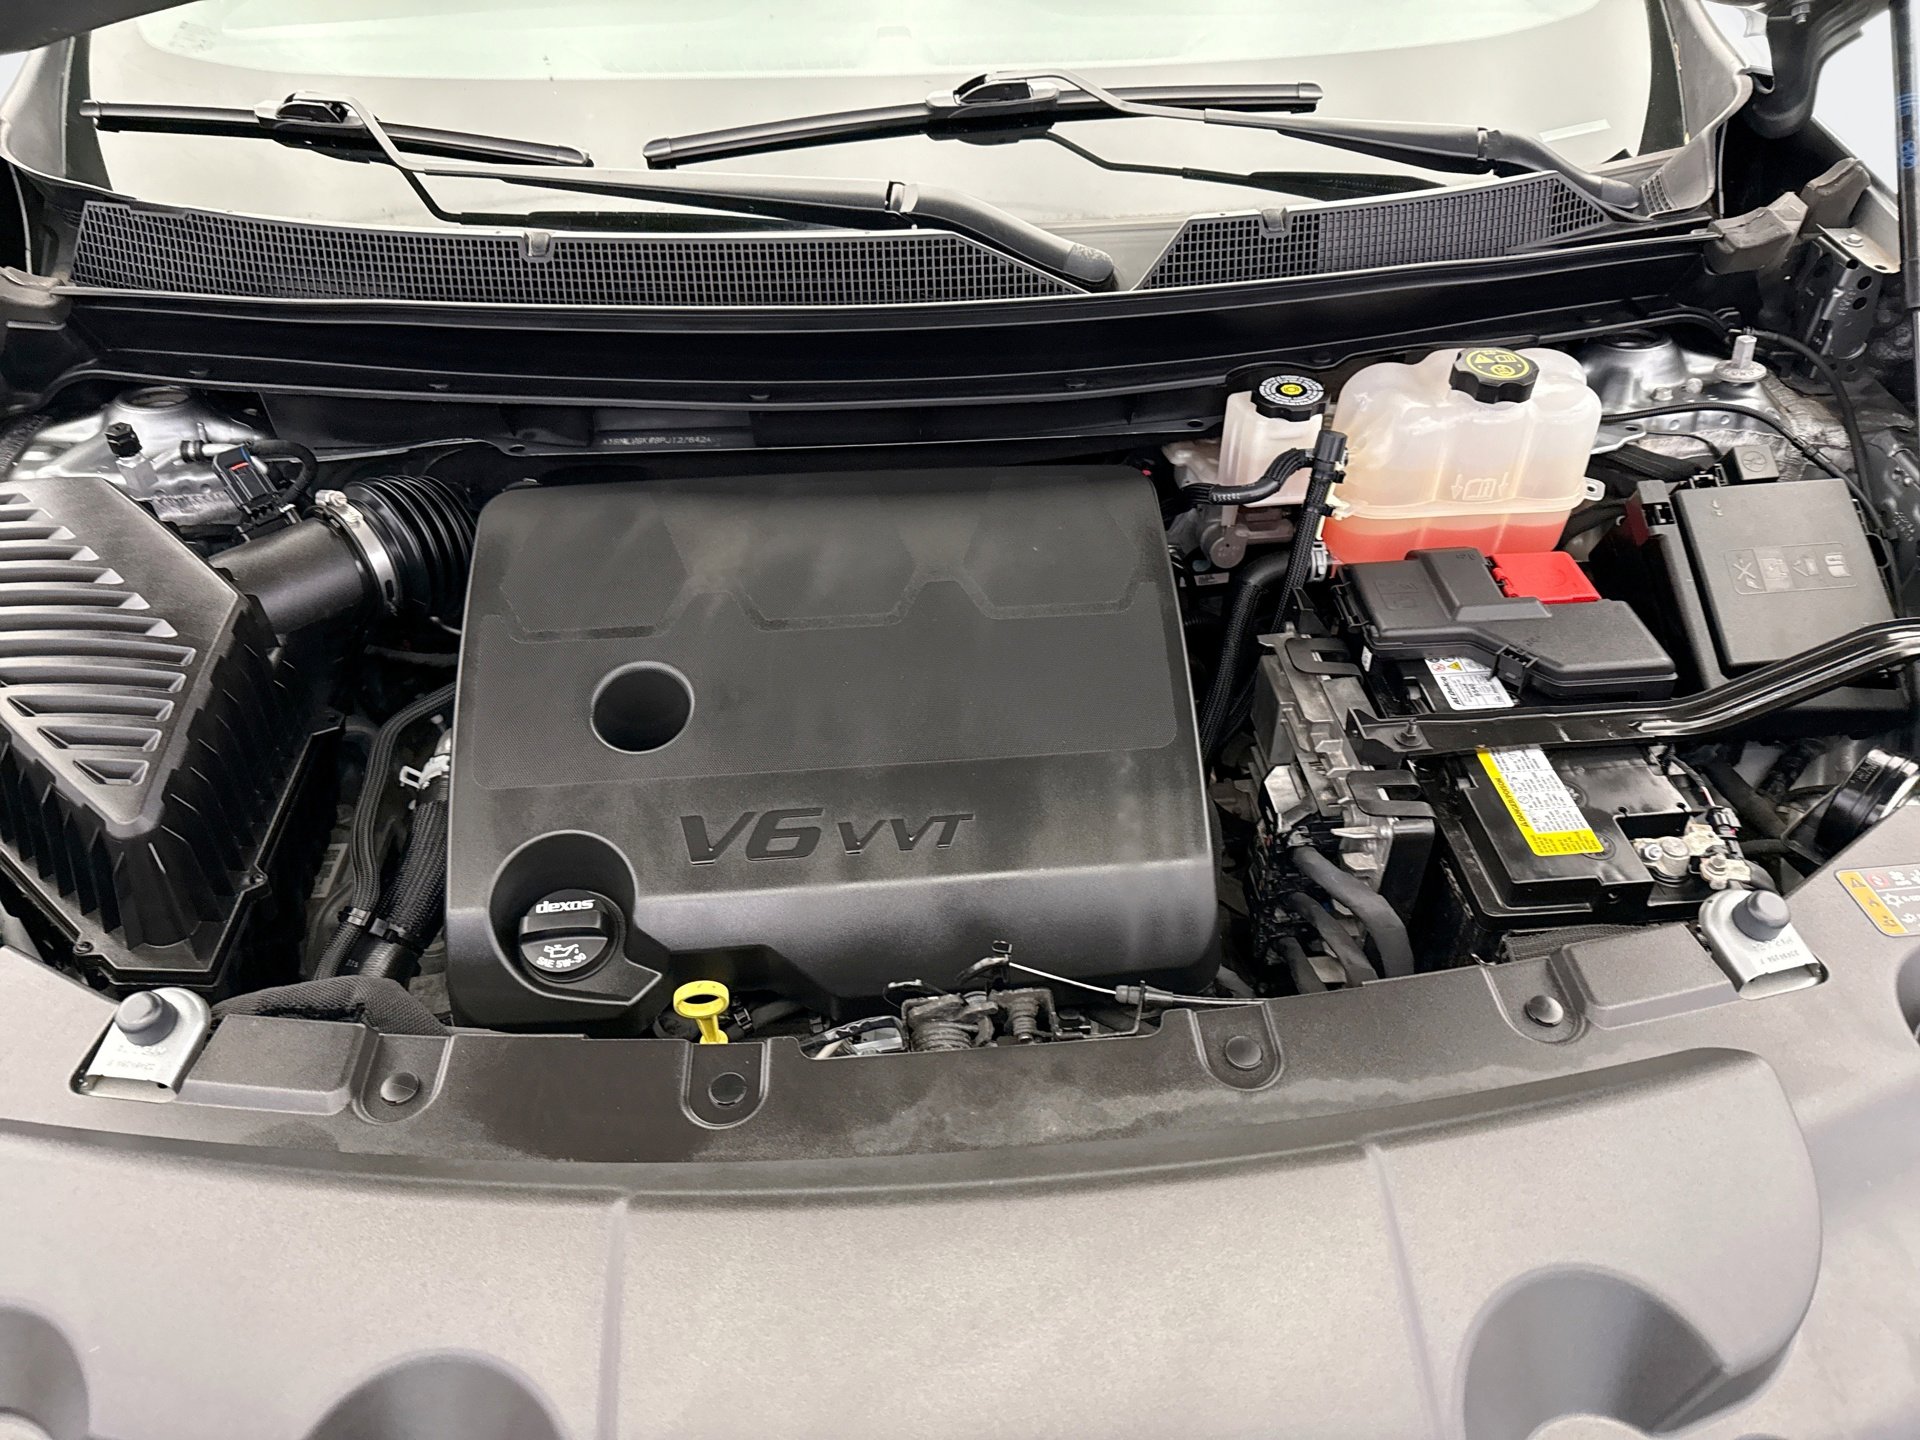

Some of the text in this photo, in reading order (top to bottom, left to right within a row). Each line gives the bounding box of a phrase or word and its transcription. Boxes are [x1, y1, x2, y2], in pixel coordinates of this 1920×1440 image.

[679, 806, 975, 866] V6 VVT
[535, 899, 596, 914] dexos
[536, 952, 587, 969] SAE 5W-30
